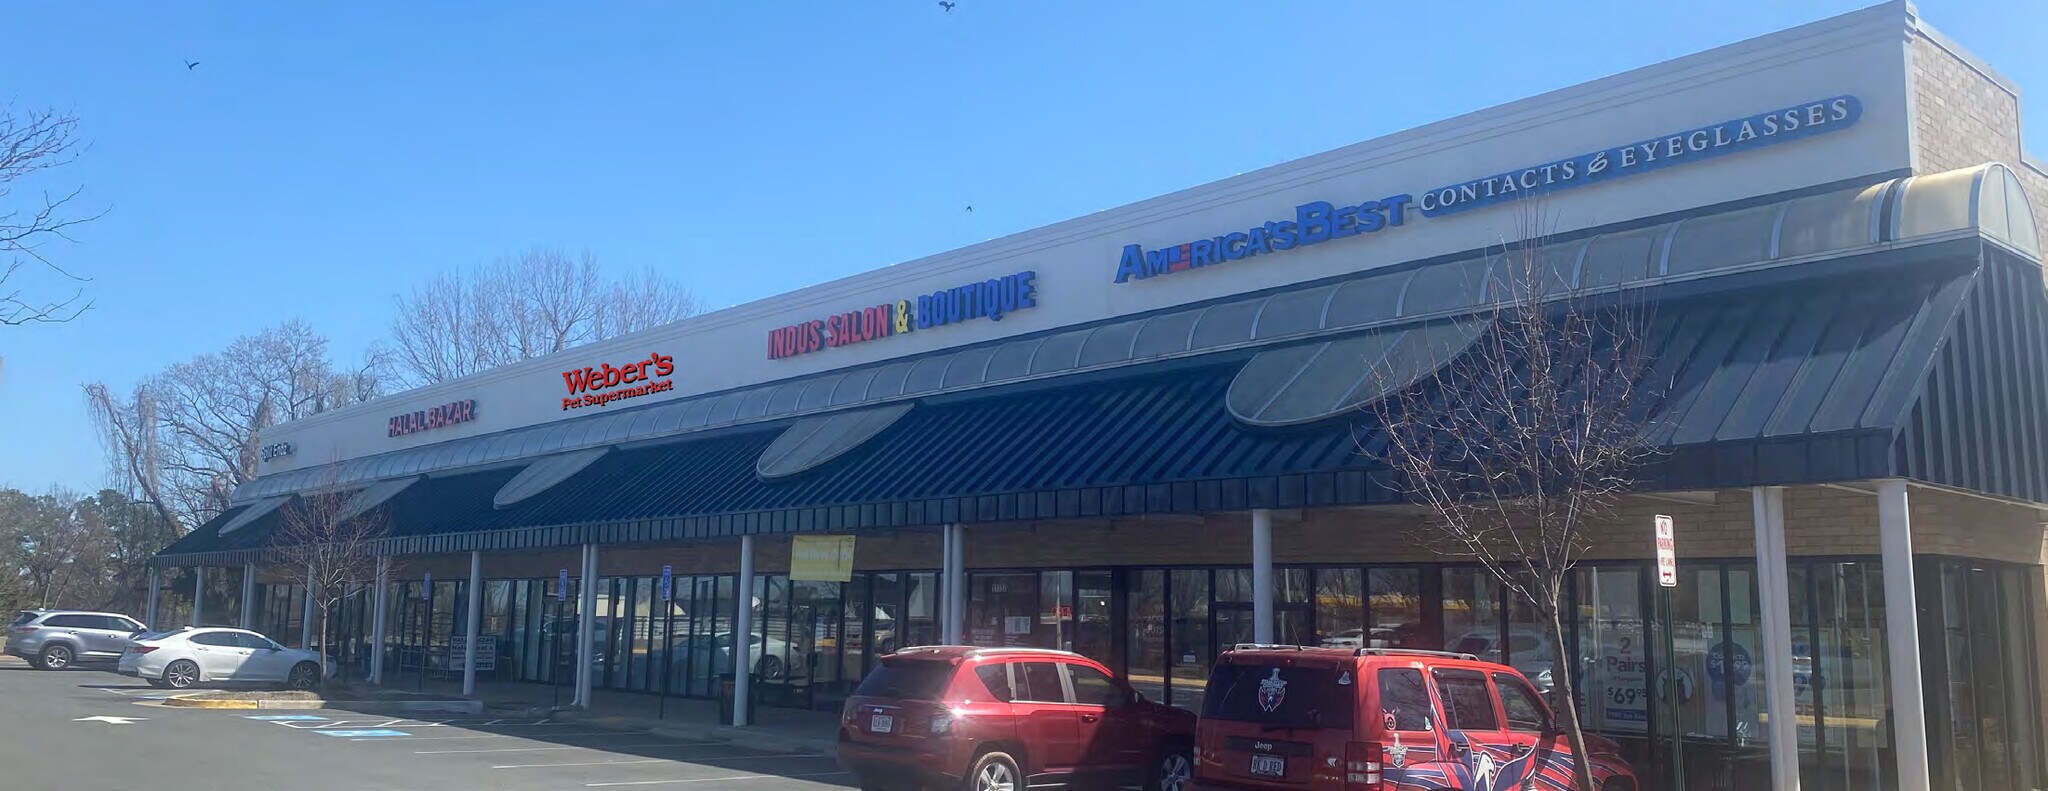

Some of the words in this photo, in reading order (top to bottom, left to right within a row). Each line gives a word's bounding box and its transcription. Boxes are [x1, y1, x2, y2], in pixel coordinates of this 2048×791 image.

[1420, 161, 1576, 212] CONTACTS
[1619, 99, 1849, 168] EYEGLASSES
[767, 319, 824, 360] INDUS
[826, 303, 893, 348] SALON
[895, 299, 912, 334] &
[918, 270, 1037, 330] BOUTIQUE
[562, 352, 674, 395] Weber's
[561, 396, 582, 411] Pet
[582, 379, 674, 406] Supermarket
[388, 410, 428, 437] HALAL
[427, 399, 476, 428] BAZAR
[1620, 637, 1632, 654] 2
[1607, 656, 1647, 673] Pairs
[1255, 742, 1272, 752] Jeep
